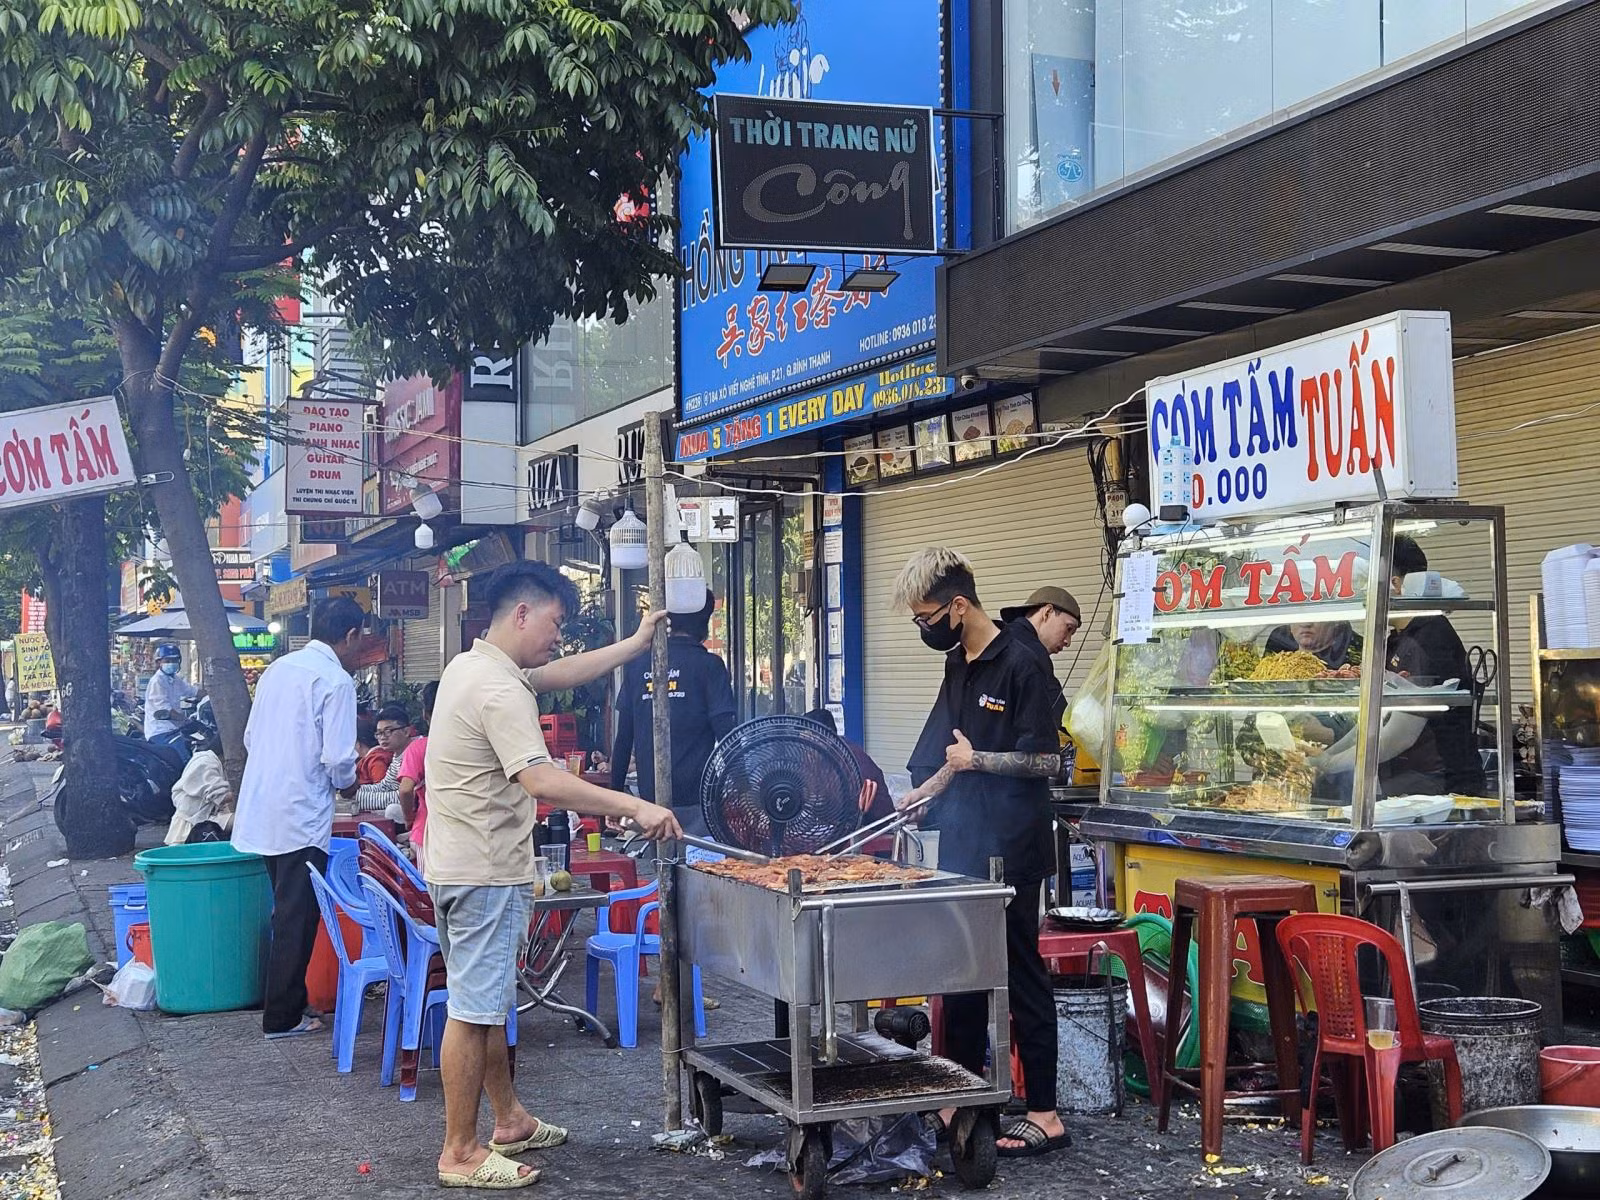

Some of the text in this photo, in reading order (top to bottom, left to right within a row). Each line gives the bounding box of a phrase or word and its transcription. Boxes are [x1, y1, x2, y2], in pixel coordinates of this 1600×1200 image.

[729, 110, 918, 154] THỜI TRANG NỮ
[892, 323, 911, 342] 0936
[912, 319, 927, 335] 018
[809, 350, 831, 371] THẠNH
[329, 407, 350, 419] TẠO
[1222, 357, 1298, 458] TẤM
[1300, 328, 1396, 482] TUẤN
[309, 422, 343, 433] PIANO
[679, 383, 866, 459] MUA 5 TẶNG 1 EVERY DAY
[50, 408, 119, 485] TẤM
[331, 439, 360, 451] NHẠC
[306, 454, 345, 464] GUITAR
[310, 470, 341, 480] DRUM
[528, 456, 564, 511] RUZA
[1153, 562, 1226, 613] ƠM
[1239, 533, 1359, 606] TẤM
[383, 580, 426, 595] ATM
[402, 608, 420, 616] MSB
[21, 646, 38, 654] SINH
